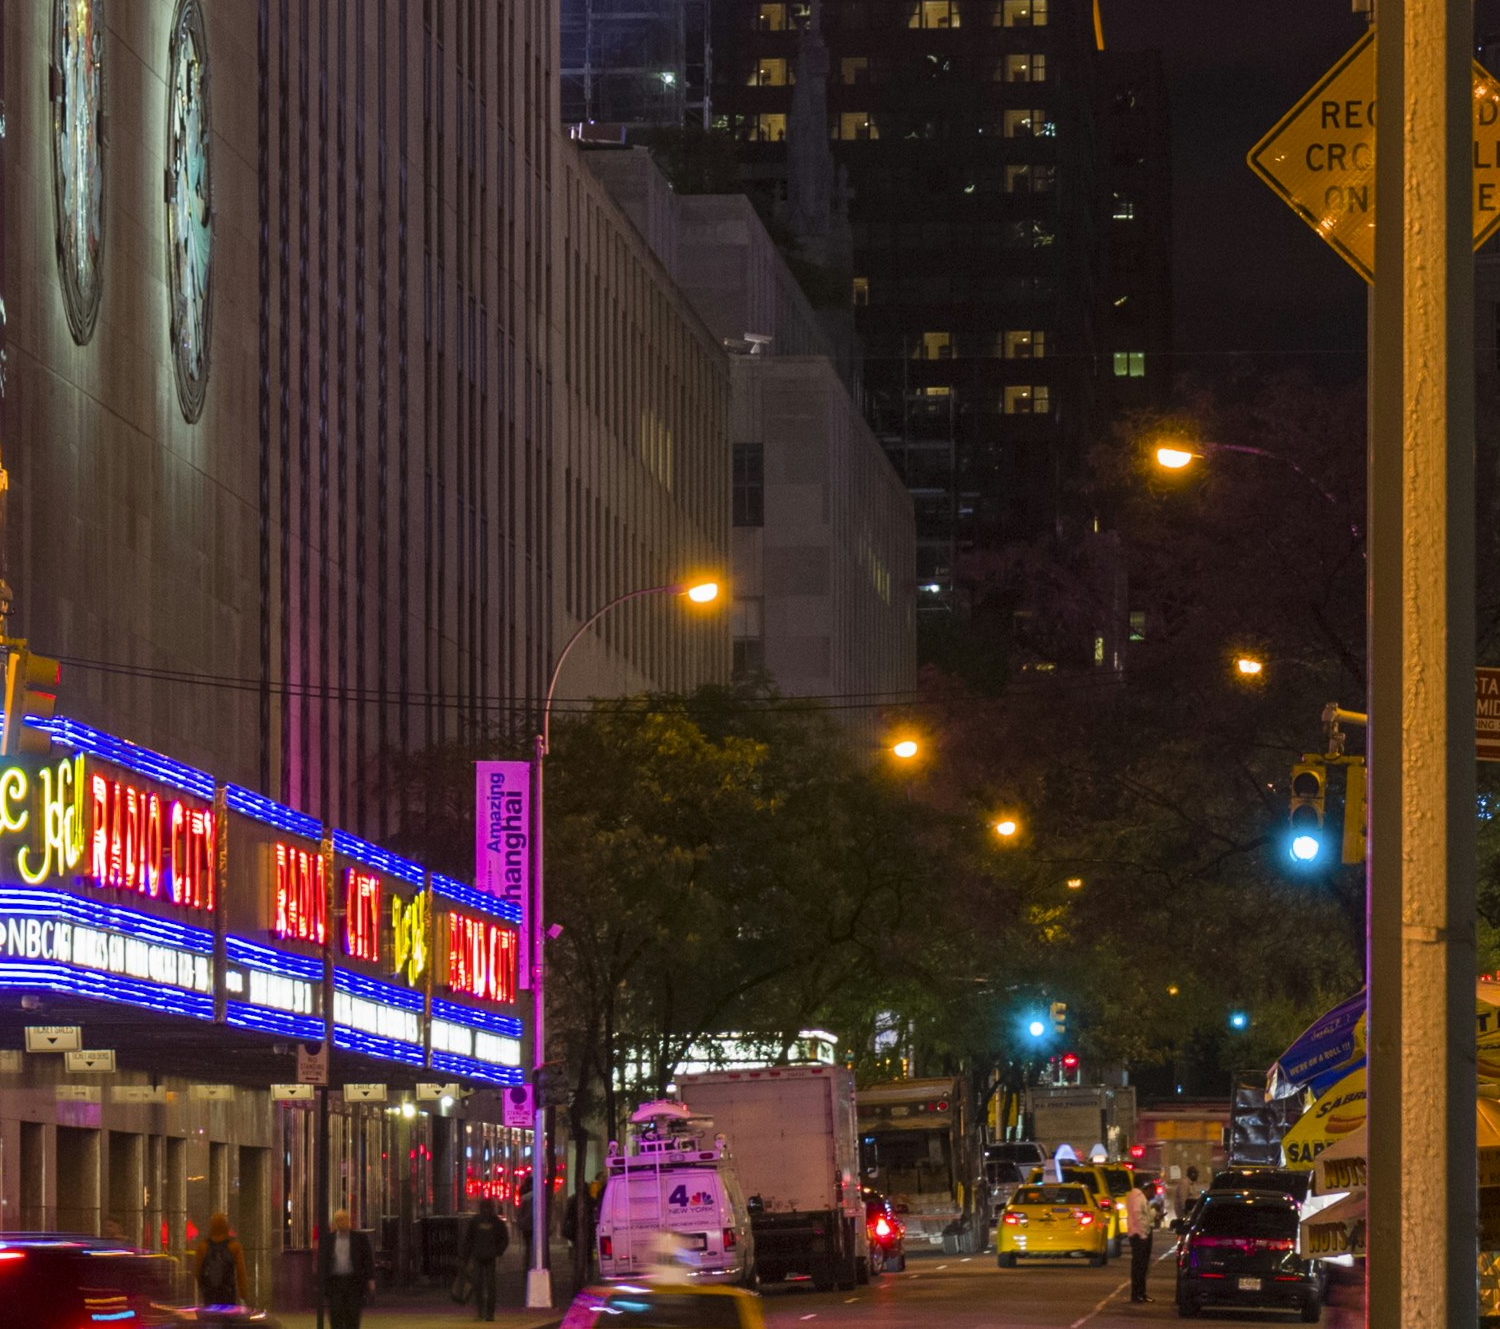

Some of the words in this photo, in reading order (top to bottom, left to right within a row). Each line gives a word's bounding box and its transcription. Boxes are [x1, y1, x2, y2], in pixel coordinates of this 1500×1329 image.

[487, 772, 505, 853] Amazing
[500, 790, 527, 908] hanghai
[669, 1184, 689, 1207] 4
